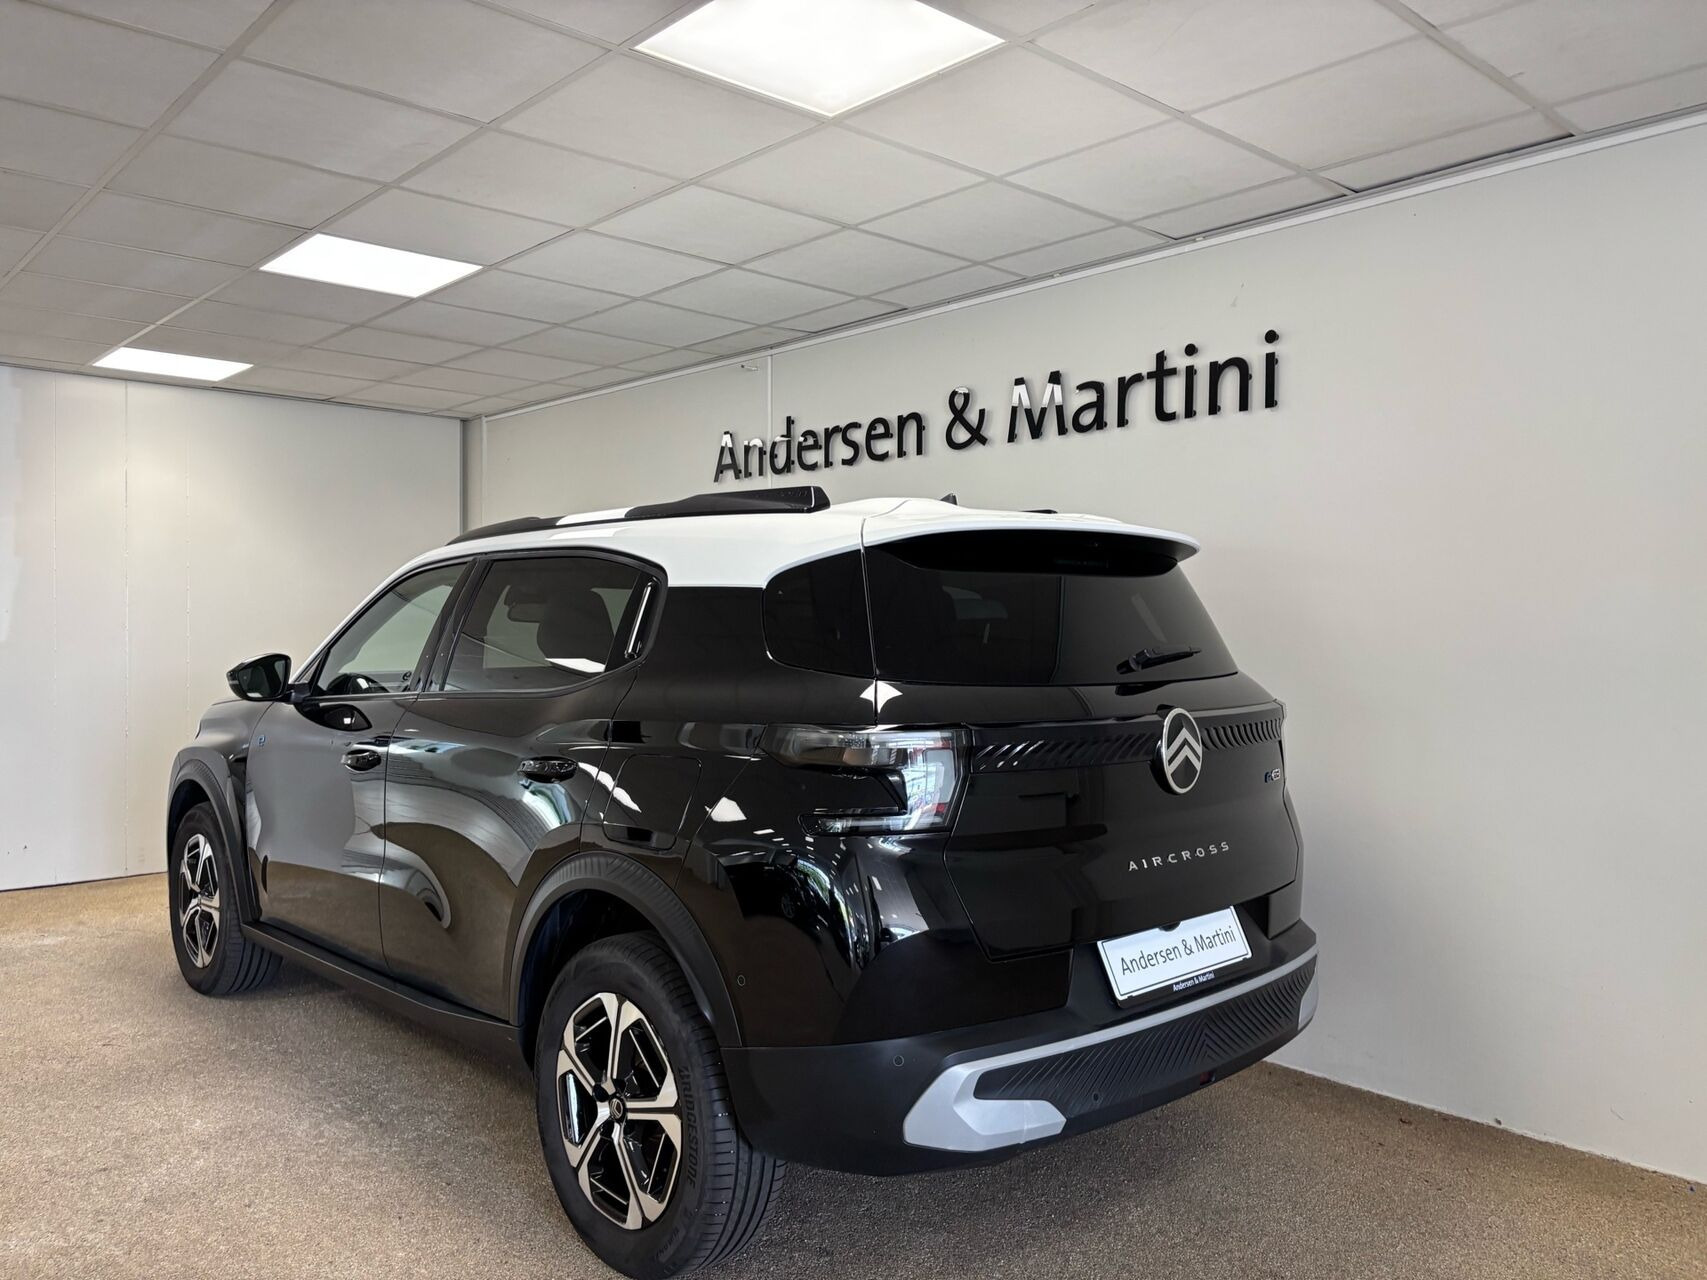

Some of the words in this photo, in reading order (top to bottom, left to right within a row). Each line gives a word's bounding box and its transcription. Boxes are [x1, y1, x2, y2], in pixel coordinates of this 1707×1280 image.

[714, 411, 925, 483] Andersen
[945, 385, 989, 451] &
[1007, 329, 1281, 443] Martini
[1128, 841, 1229, 871] AIRCROSS
[1121, 945, 1182, 975] Andersen
[1182, 938, 1194, 956] &
[1193, 925, 1237, 952] Martini
[1173, 980, 1195, 992] Andersen
